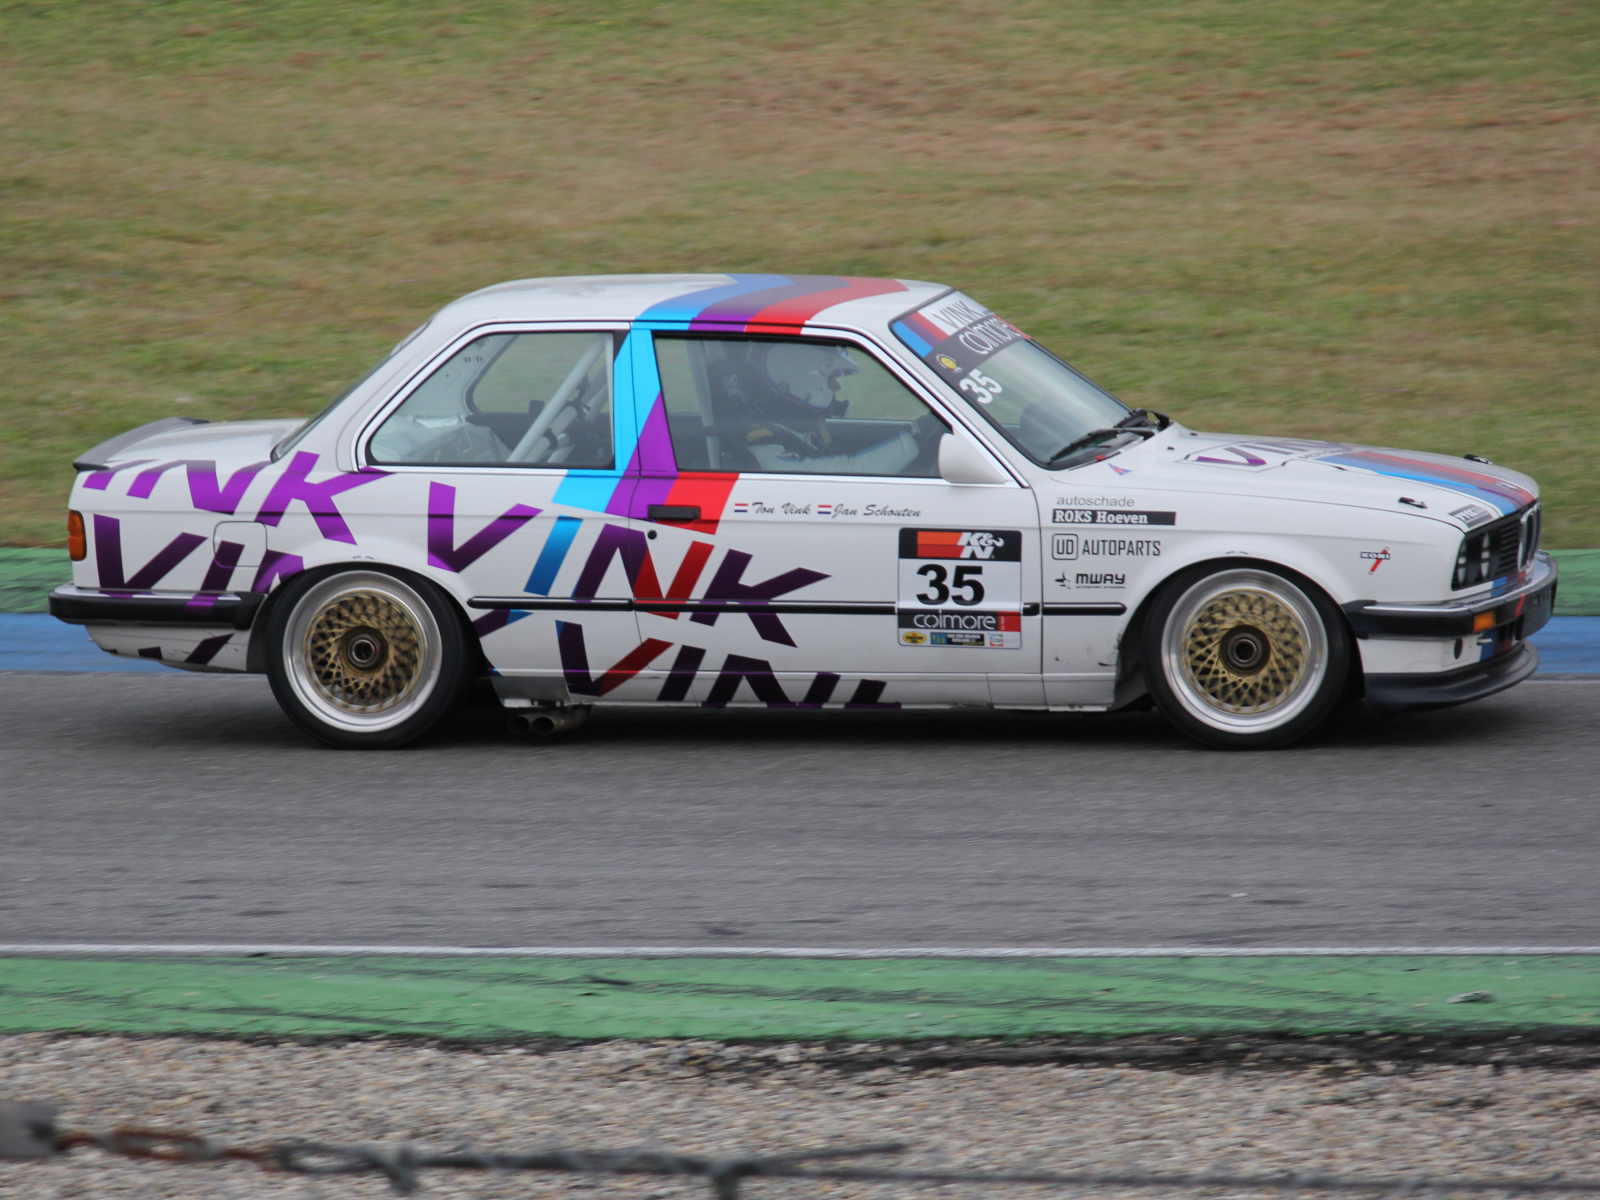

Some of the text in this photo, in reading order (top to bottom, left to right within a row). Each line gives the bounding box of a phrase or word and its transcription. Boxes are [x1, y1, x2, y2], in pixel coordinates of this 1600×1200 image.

[932, 300, 985, 330] VINK
[958, 317, 1022, 355] colmore
[958, 368, 1003, 404] 35
[752, 502, 812, 515] Ton Vink
[832, 503, 922, 518] Jan Schouten
[1057, 496, 1135, 507] autoschade
[1054, 510, 1149, 524] ROKS Hoeven
[1057, 539, 1162, 556] UD AUTOPARTS
[1361, 552, 1390, 560] KONI
[428, 481, 833, 648] VINK
[916, 563, 985, 607] 35
[913, 609, 997, 630] colmore
